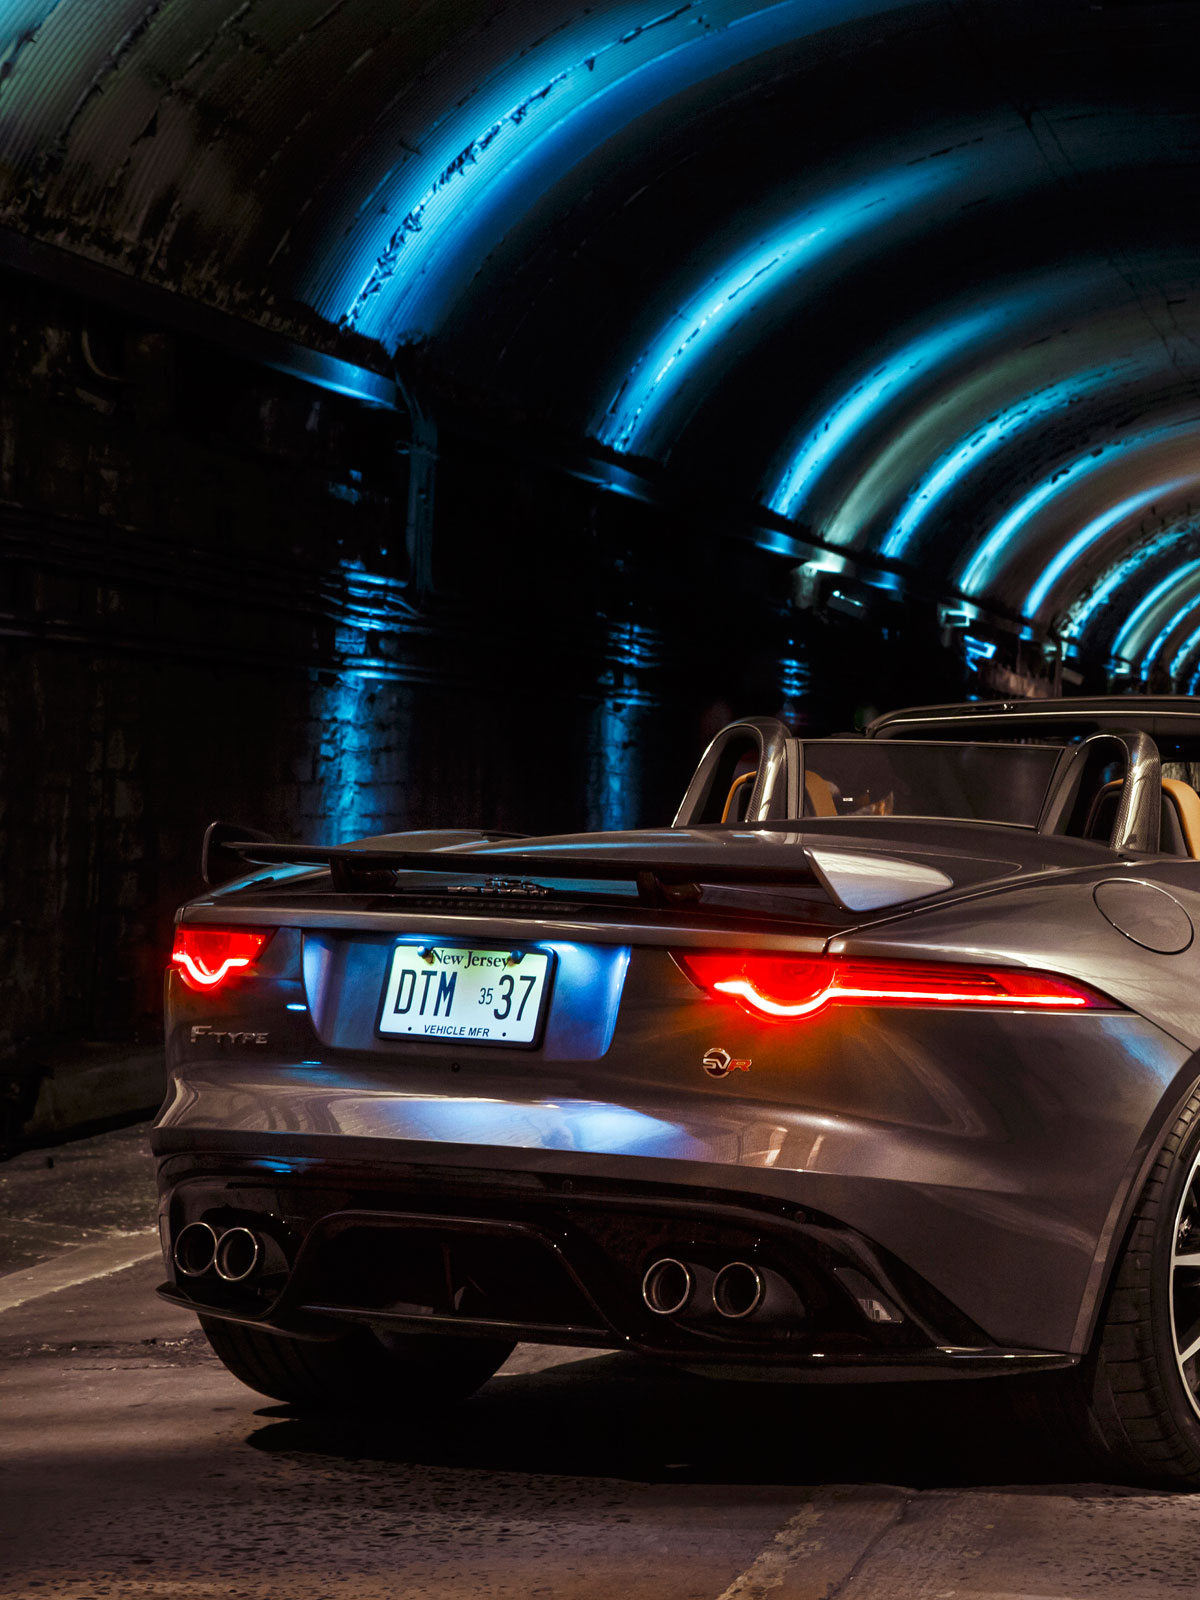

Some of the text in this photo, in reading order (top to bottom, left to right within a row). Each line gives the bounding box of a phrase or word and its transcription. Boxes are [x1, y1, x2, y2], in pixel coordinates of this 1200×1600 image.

[432, 949, 510, 971] New Jersey
[393, 969, 537, 1022] DTM 35 37
[423, 1024, 490, 1038] VEHICLE MFR
[702, 1055, 752, 1073] SVR
